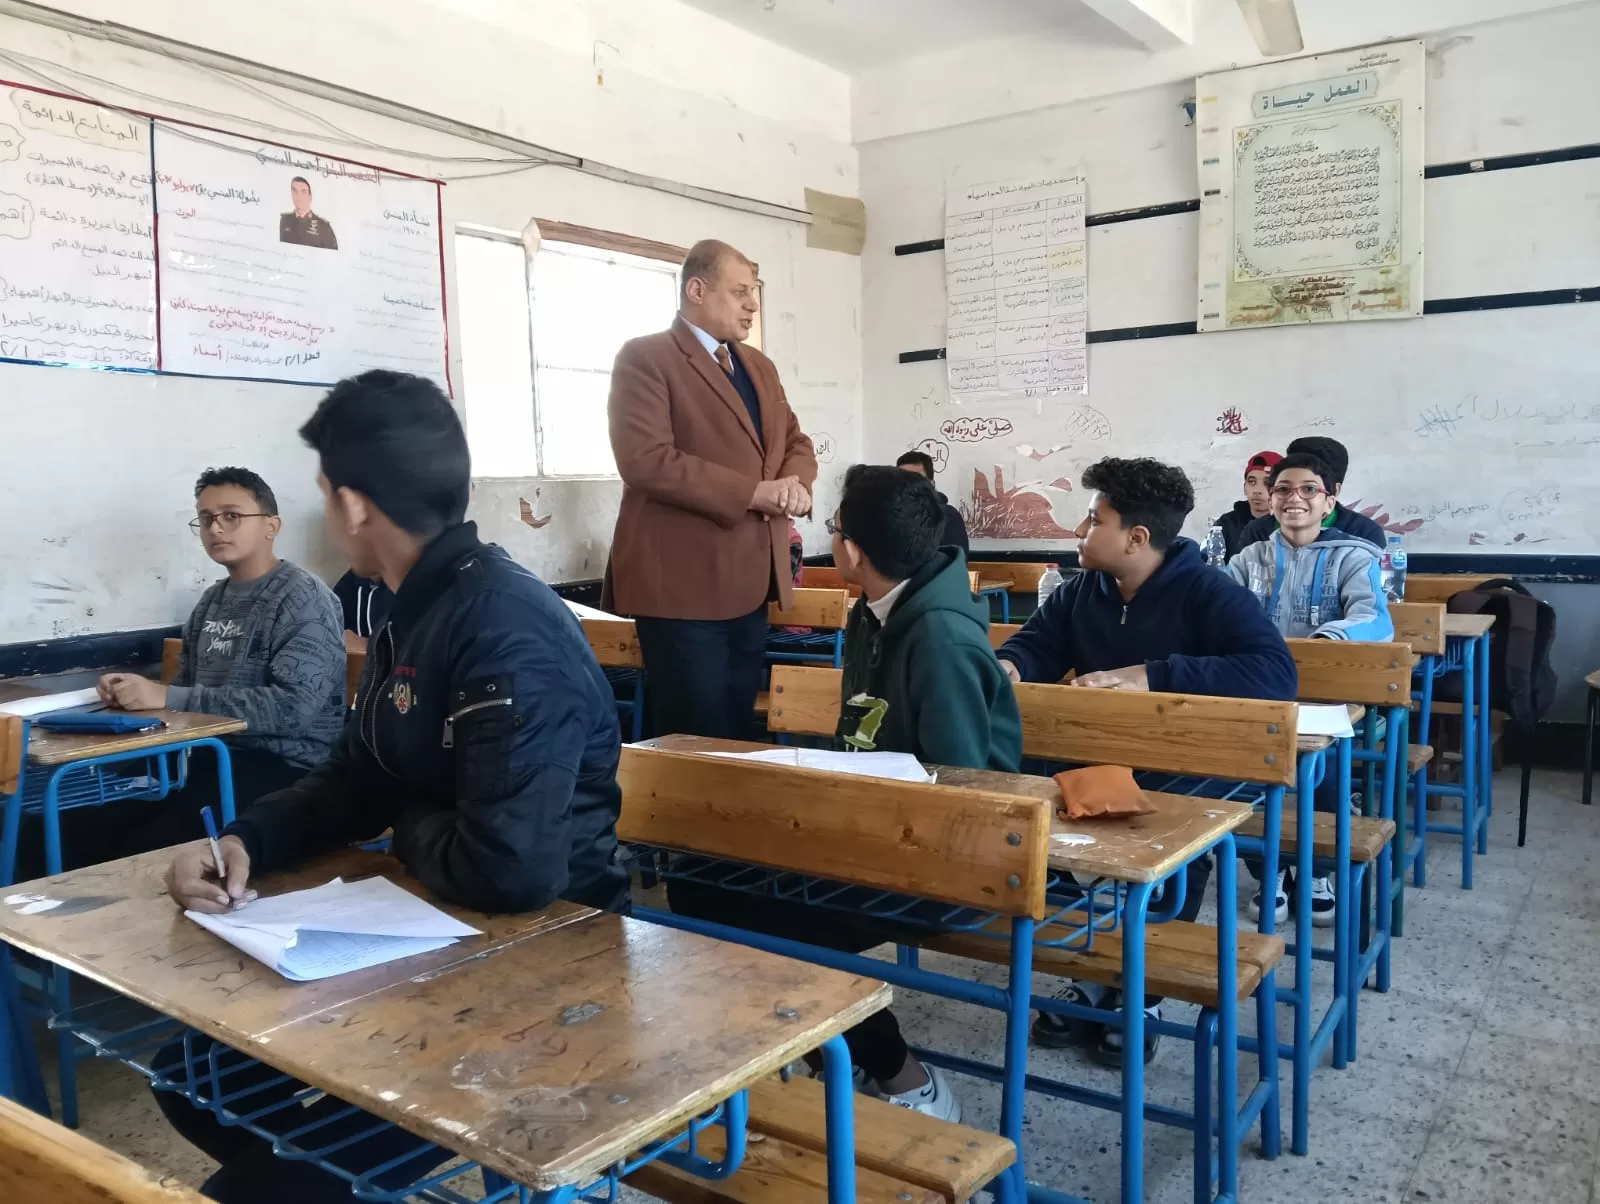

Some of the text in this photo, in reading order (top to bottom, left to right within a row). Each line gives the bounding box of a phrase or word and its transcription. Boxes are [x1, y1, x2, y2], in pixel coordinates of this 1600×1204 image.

[1262, 79, 1368, 110] العمل حياة
[22, 100, 74, 124] الدائمة
[111, 169, 126, 185] في
[193, 343, 222, 361] أسماء
[970, 423, 987, 437] على
